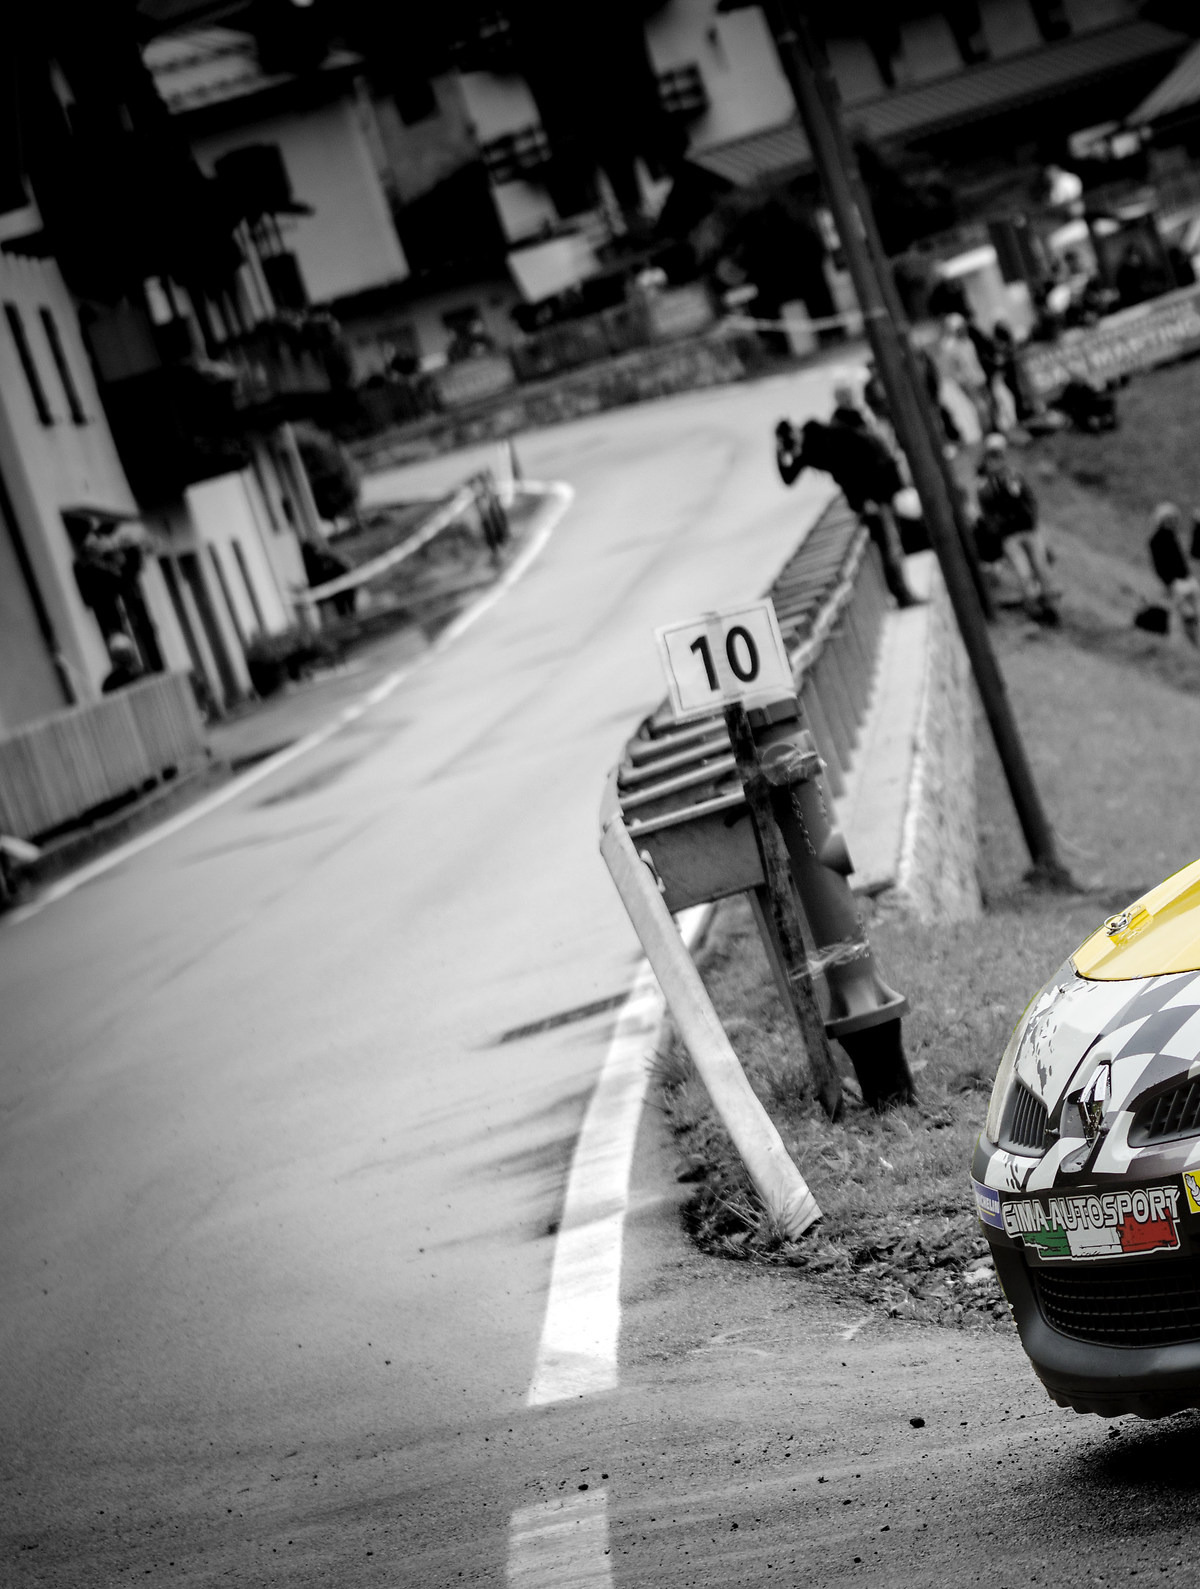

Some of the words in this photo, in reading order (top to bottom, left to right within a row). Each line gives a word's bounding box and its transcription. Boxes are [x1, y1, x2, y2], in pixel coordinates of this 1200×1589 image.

[690, 624, 761, 692] 10
[1002, 1200, 1050, 1232] GIMA
[1048, 1187, 1179, 1232] AUTOSPORT
